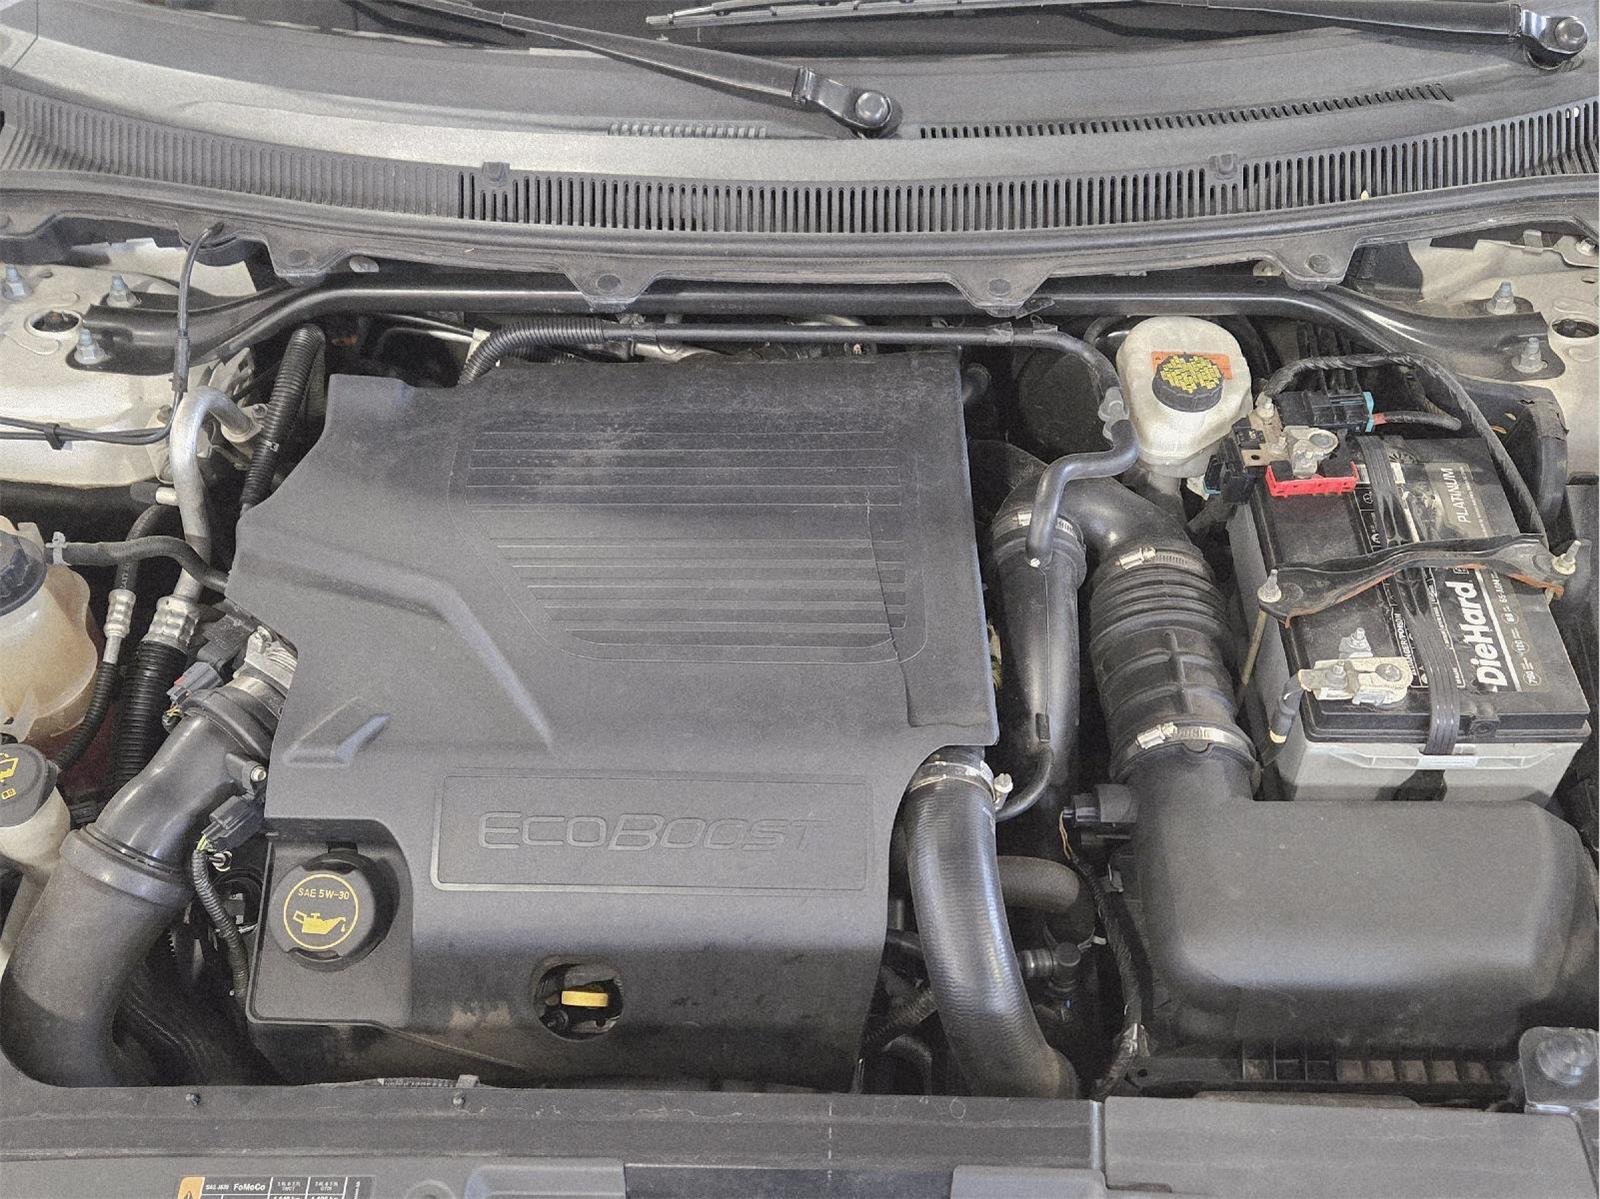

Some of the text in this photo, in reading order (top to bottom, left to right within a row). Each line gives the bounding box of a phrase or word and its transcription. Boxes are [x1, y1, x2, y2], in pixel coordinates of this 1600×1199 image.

[1440, 467, 1471, 523] PLATINUM
[1445, 581, 1508, 686] DieHard
[298, 887, 350, 900] SAE 5W-30
[233, 1183, 266, 1191] FoMoCo
